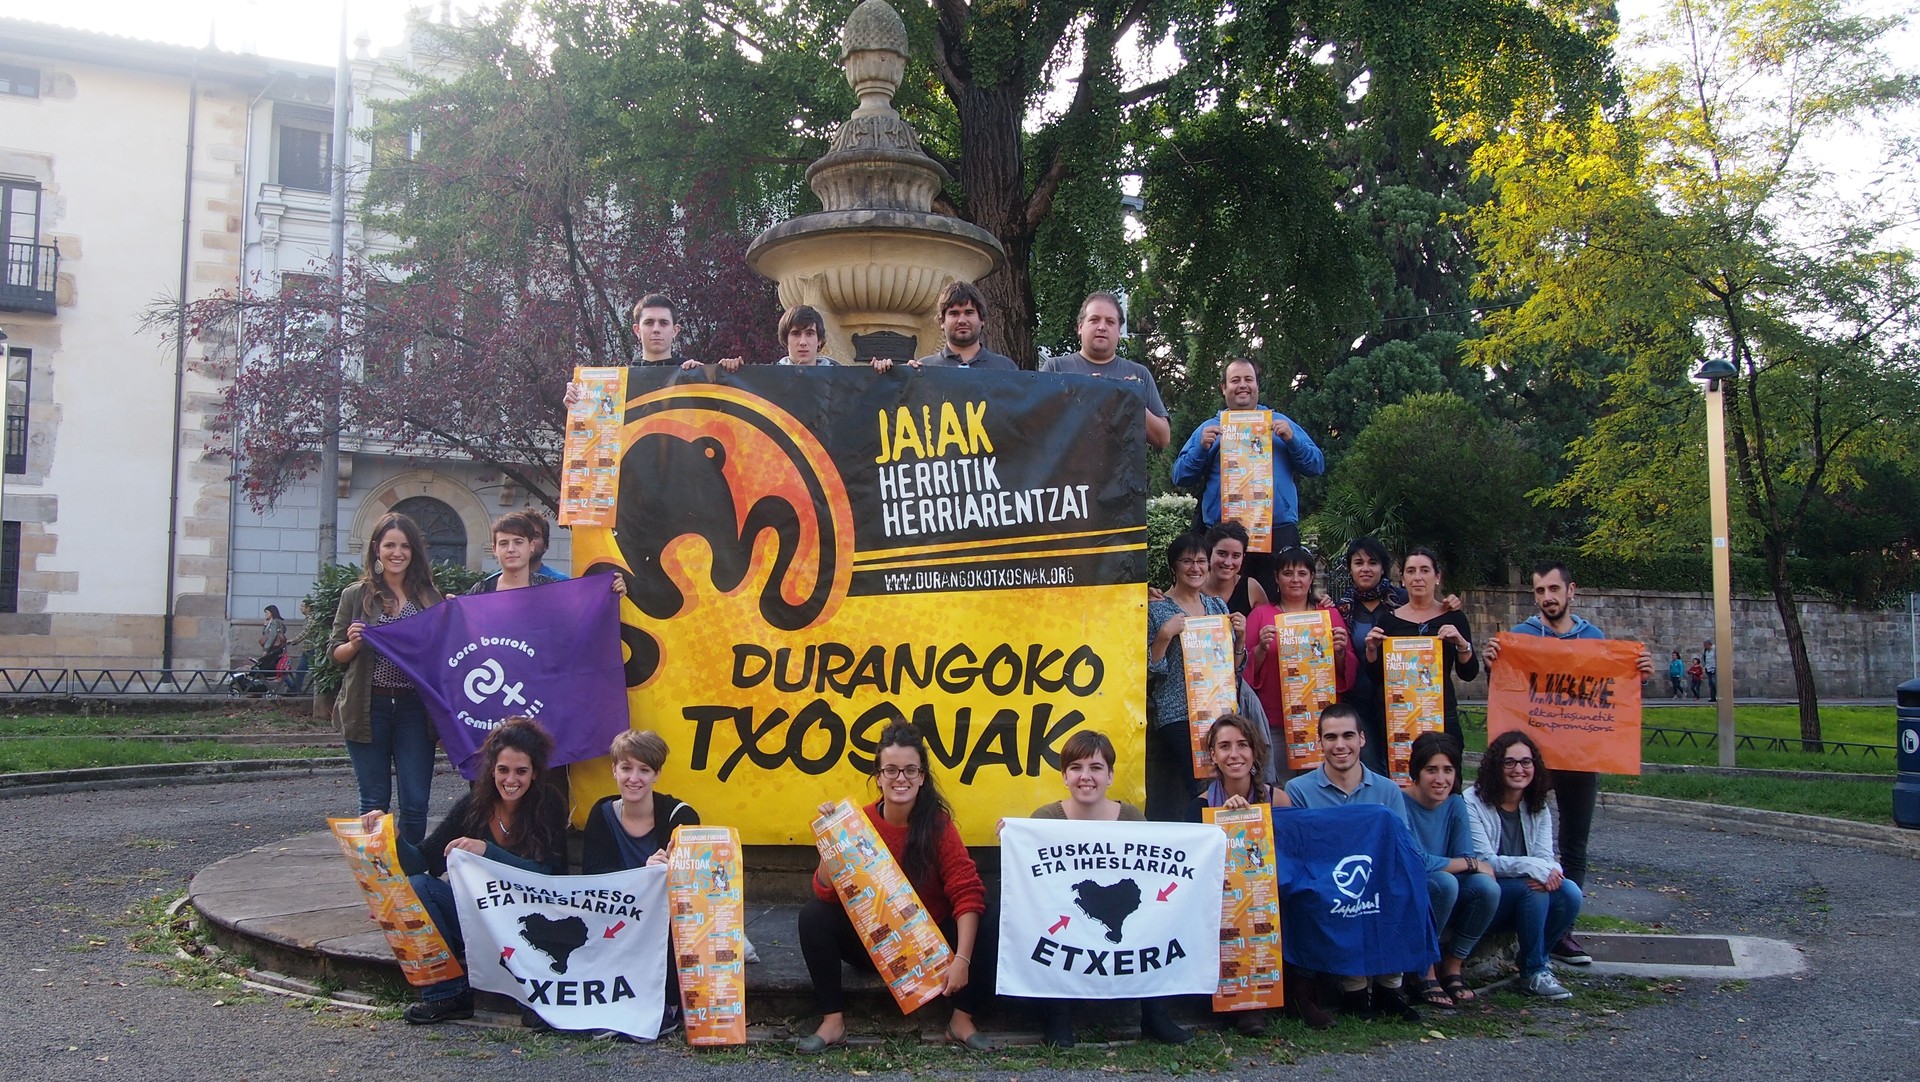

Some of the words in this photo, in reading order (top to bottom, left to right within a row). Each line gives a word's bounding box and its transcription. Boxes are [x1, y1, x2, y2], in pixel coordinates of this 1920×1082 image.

[875, 401, 994, 464] JAIAK
[1222, 424, 1237, 433] SAN
[1222, 432, 1250, 441] FAUSTOAK
[879, 456, 1001, 501] HERRITIK
[882, 485, 1090, 538] HERRIARENTZAT
[884, 566, 1074, 592] WWW.DURANGOKOTXOSNAK.ORG
[1182, 631, 1198, 640] SAN
[1279, 628, 1294, 638] SAN
[1280, 636, 1310, 646] FAUSTOAK
[448, 642, 478, 668] Gora
[480, 636, 535, 658] borroka
[1386, 652, 1402, 662] SAN
[732, 642, 1105, 698] DURANGOKO
[1386, 662, 1418, 671] FAUSTOAK
[682, 699, 1086, 786] TXOSNAK
[1308, 742, 1315, 752] 12
[821, 838, 854, 862] FAUSTOAK
[1038, 842, 1116, 861] EUSKAL
[1124, 842, 1186, 863] PRESO
[670, 858, 710, 871] FAUSTOAK
[1031, 860, 1067, 878] ETA
[1074, 856, 1196, 880] IHESLARIAK
[486, 880, 564, 898] EUSKAL
[571, 889, 636, 905] PRESO
[732, 888, 740, 900] 13
[476, 892, 516, 910] ETA
[523, 892, 644, 922] IHESLARIAK
[1268, 902, 1278, 914] 16
[696, 912, 704, 925] 10
[733, 928, 742, 940] 16
[1270, 932, 1279, 944] 17
[1238, 936, 1245, 948] 11
[1030, 936, 1187, 977] ETXERA
[410, 960, 420, 970] 12
[697, 964, 704, 978] 11
[734, 962, 742, 974] 17
[912, 964, 925, 978] 12
[1240, 975, 1248, 988] 12
[1270, 969, 1280, 981] 18
[515, 975, 636, 1006] XERA
[698, 1007, 707, 1021] 12
[732, 1001, 742, 1014] 18
